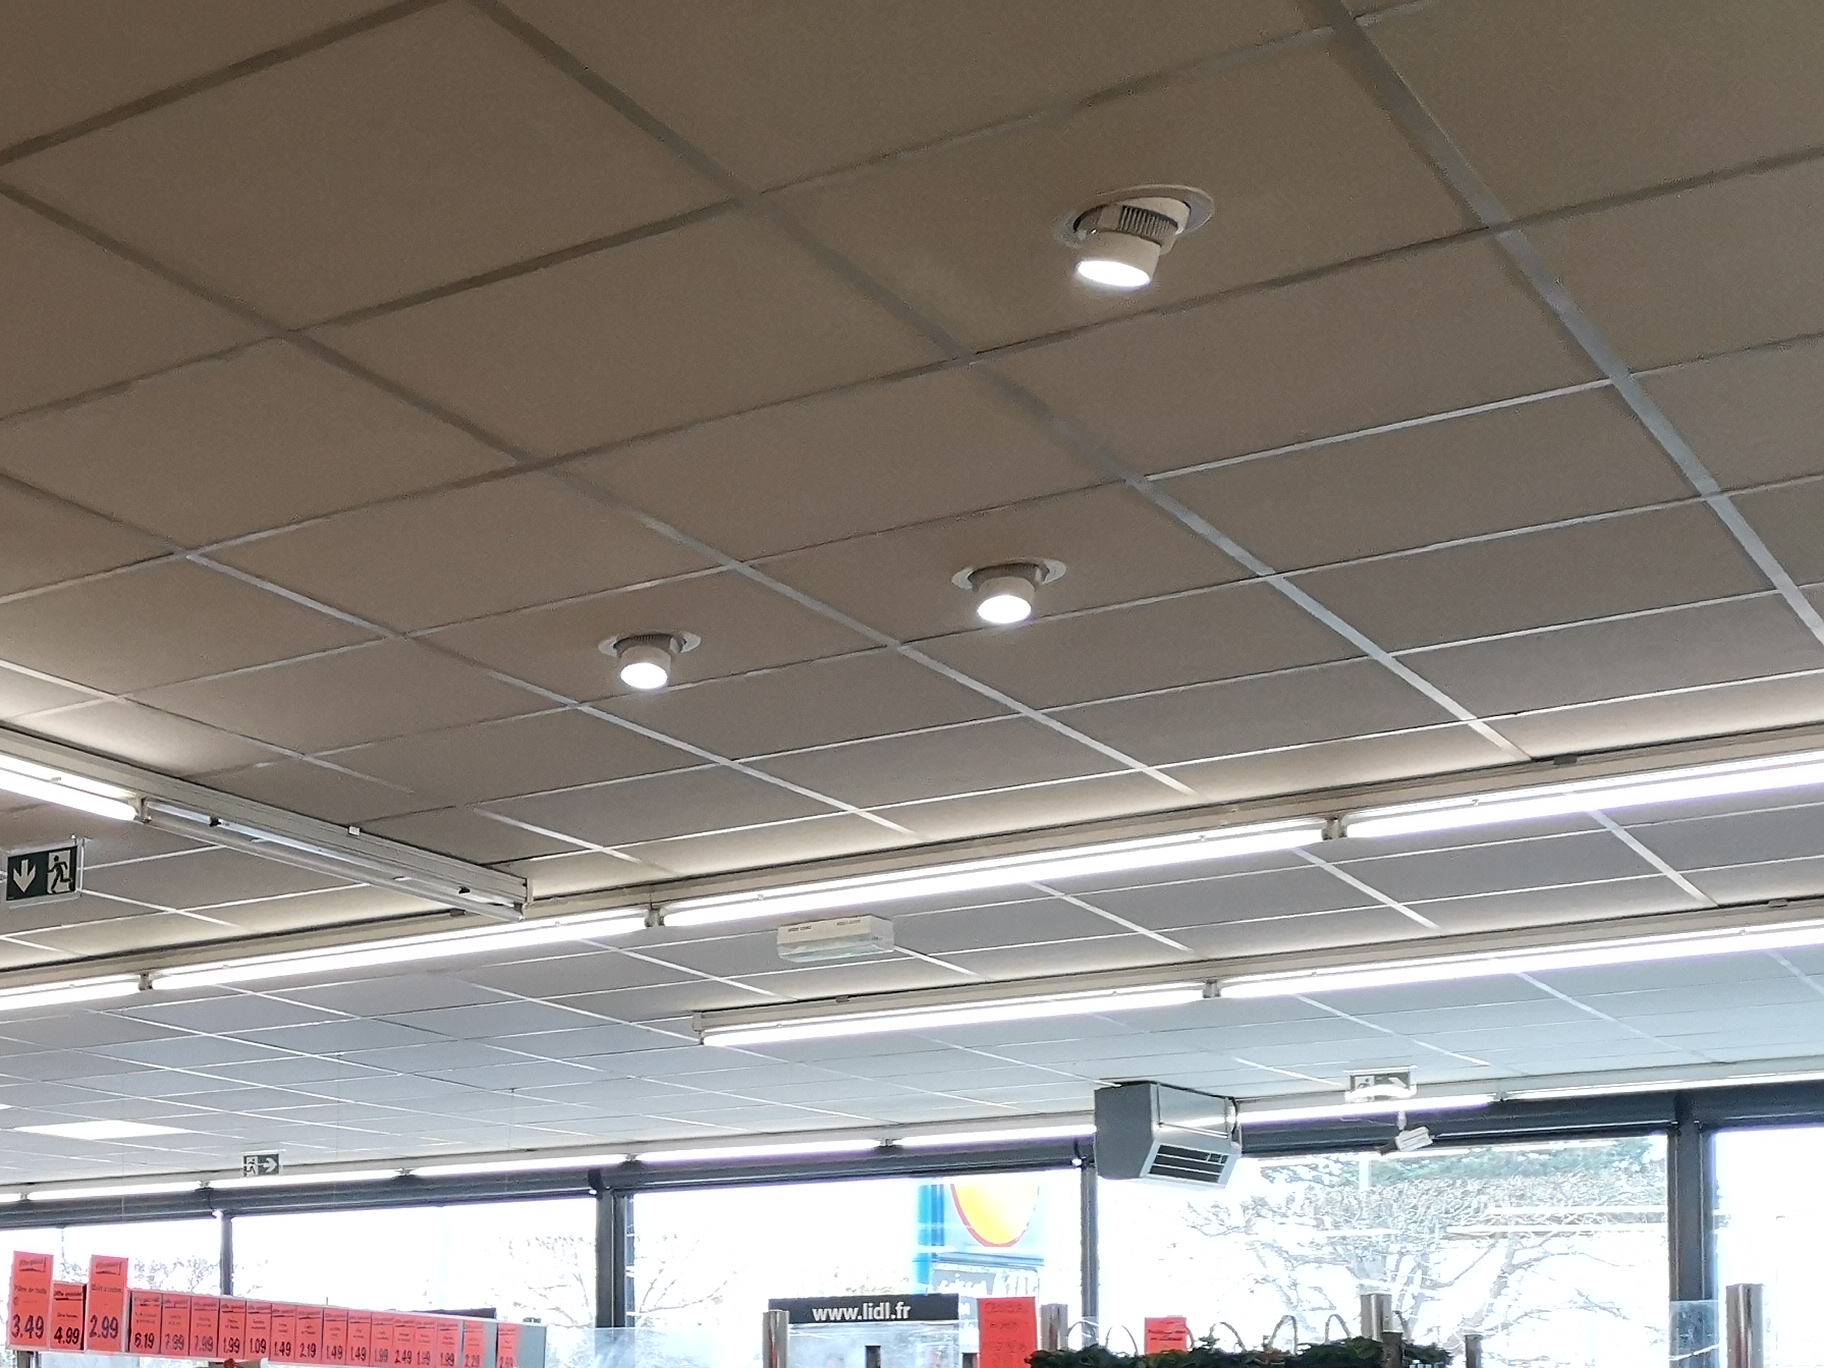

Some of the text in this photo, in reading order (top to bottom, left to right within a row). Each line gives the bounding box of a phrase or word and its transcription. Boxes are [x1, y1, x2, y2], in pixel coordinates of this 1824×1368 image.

[812, 1302, 911, 1321] www.lidl.fr
[11, 1313, 44, 1339] 3.49
[54, 1326, 80, 1345] 4.99
[89, 1314, 119, 1340] 2.99
[249, 1337, 267, 1354] 1.09
[299, 1342, 316, 1358] 2.19
